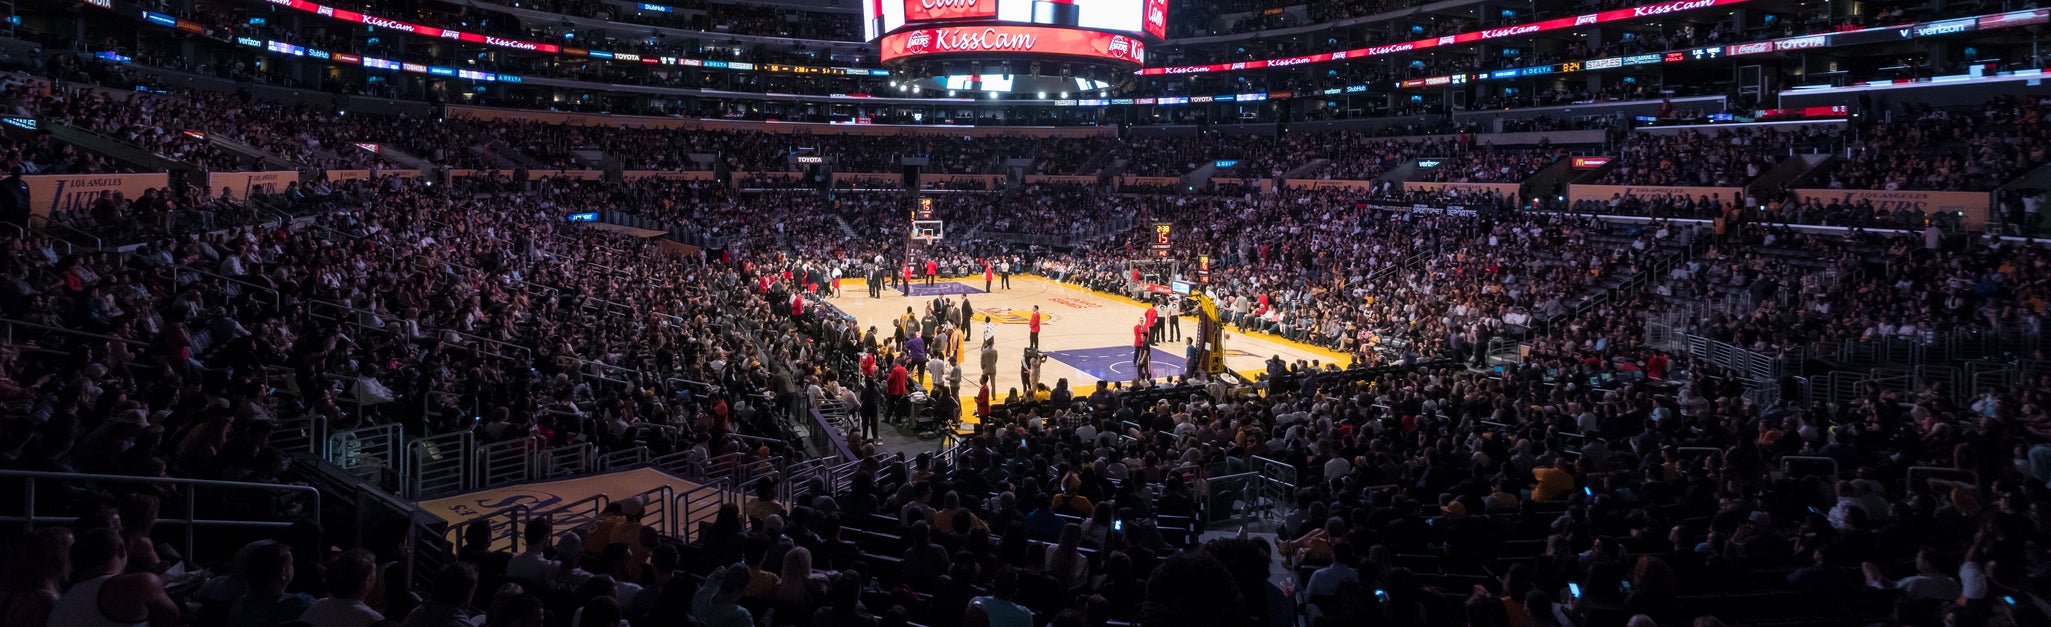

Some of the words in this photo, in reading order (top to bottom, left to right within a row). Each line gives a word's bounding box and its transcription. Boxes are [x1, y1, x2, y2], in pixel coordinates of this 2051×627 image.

[1633, 0, 1716, 17] KissCam
[362, 15, 414, 32] KissCam
[1481, 25, 1540, 40] KissCam
[1918, 23, 1965, 37] verizon
[238, 37, 261, 47] verizon
[485, 36, 537, 51] KissCam
[935, 28, 1037, 50] KissCam
[1774, 36, 1825, 50] TOYOTA
[309, 49, 330, 59] StubHub
[1368, 43, 1414, 56] KissCam
[614, 52, 640, 61] TOYOTA
[1267, 56, 1311, 67] KissCam
[403, 63, 428, 73] TOSHIBA
[1562, 62, 1580, 72] 8:24
[1587, 58, 1622, 69] STAPLES
[1165, 66, 1210, 74] KissCam
[1528, 66, 1552, 74] DELTA
[1346, 85, 1366, 93] StubHub
[70, 179, 86, 188] LOS
[86, 178, 122, 187] ANGELES
[1157, 225, 1170, 233] 2:38
[1158, 232, 1168, 243] 15
